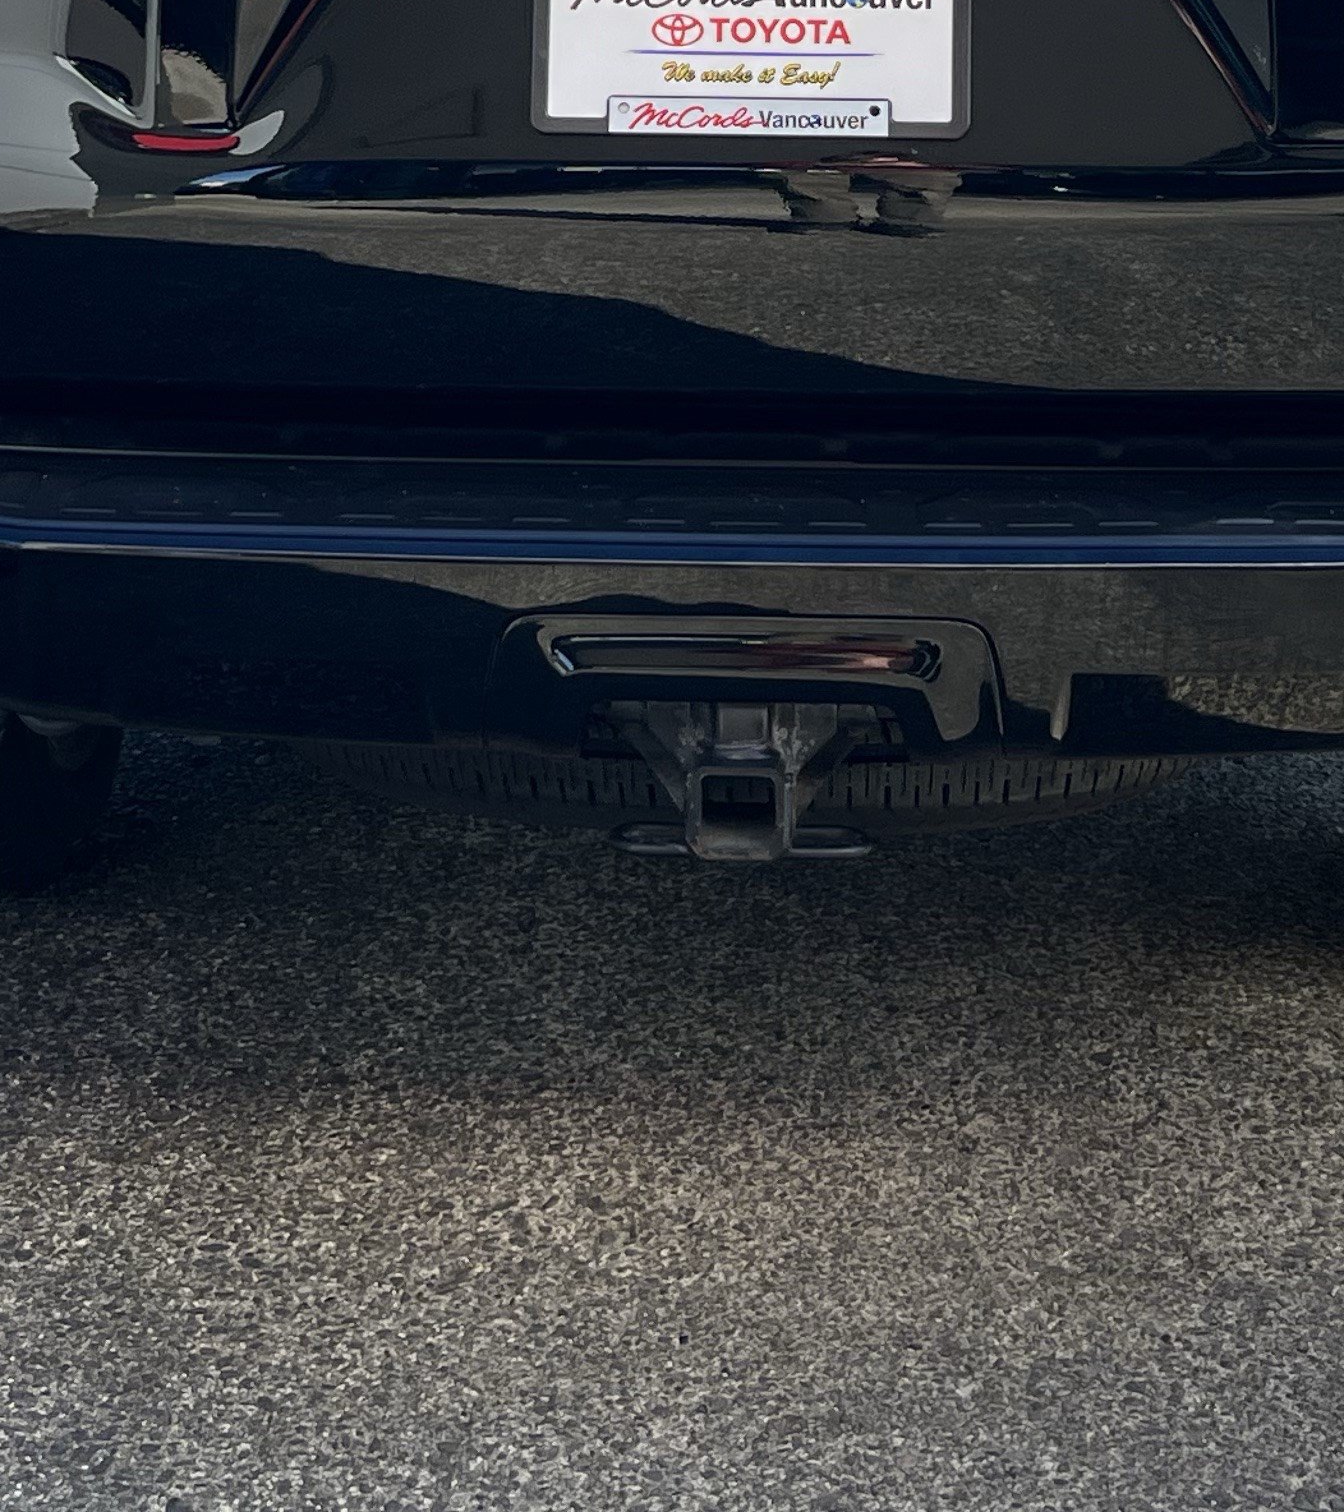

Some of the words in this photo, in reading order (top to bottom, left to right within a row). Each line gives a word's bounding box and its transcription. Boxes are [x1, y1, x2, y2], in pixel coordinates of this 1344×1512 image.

[709, 17, 851, 44] TOYOTA
[661, 60, 696, 83] We
[701, 63, 753, 83] make
[758, 66, 777, 84] it
[780, 60, 842, 89] Easy!
